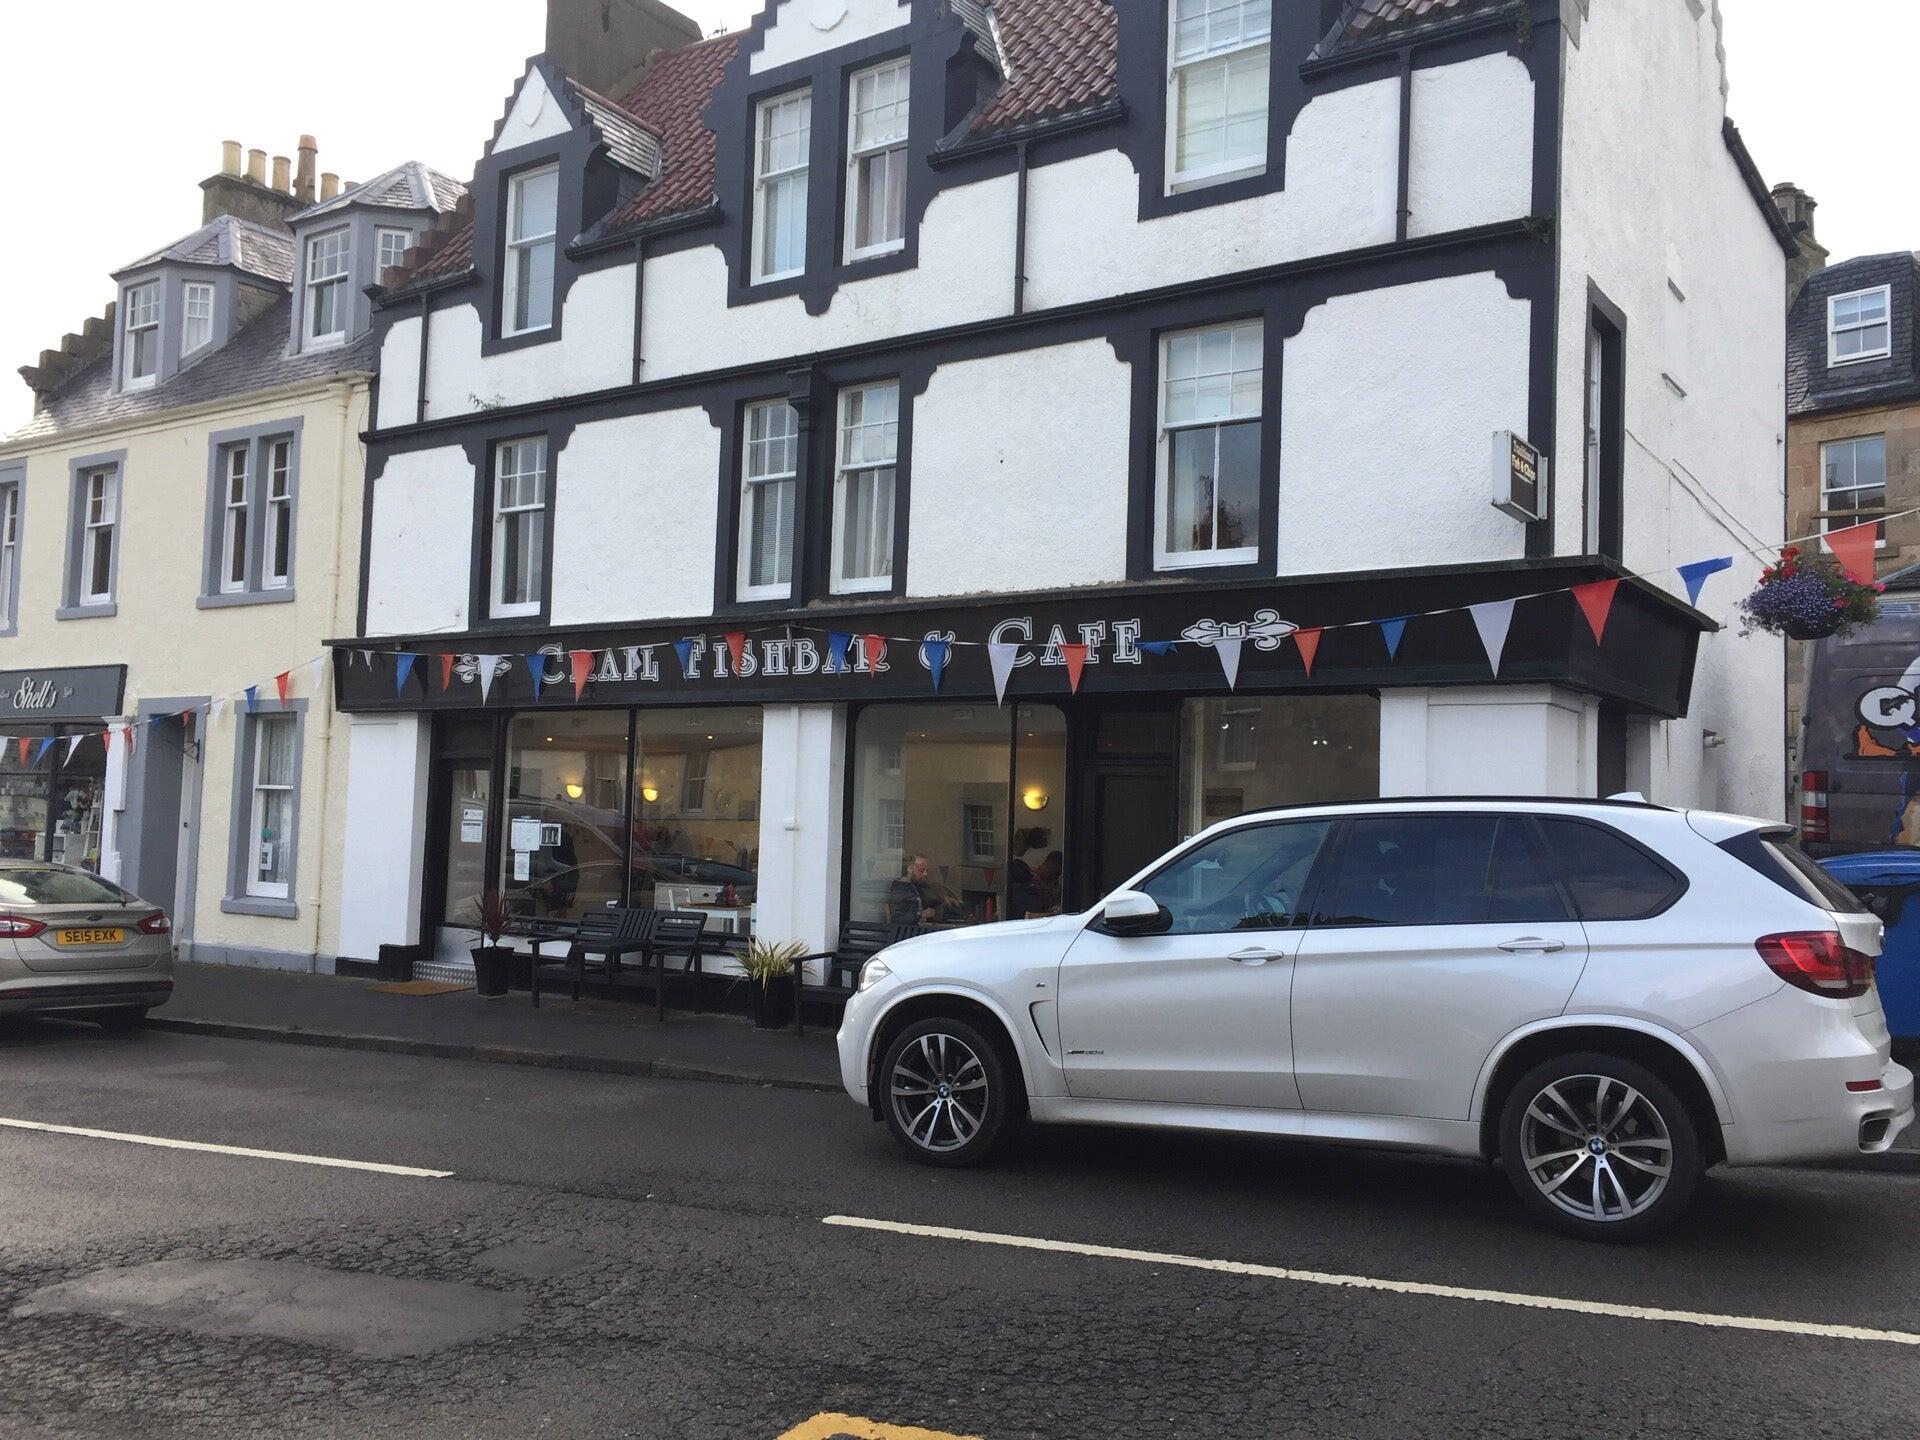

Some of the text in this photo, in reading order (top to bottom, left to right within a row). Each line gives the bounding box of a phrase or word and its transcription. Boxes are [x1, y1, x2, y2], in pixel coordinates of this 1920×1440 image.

[988, 616, 1142, 668] CAFE
[13, 677, 57, 709] Shell's
[65, 930, 117, 942] SE15 EXK
